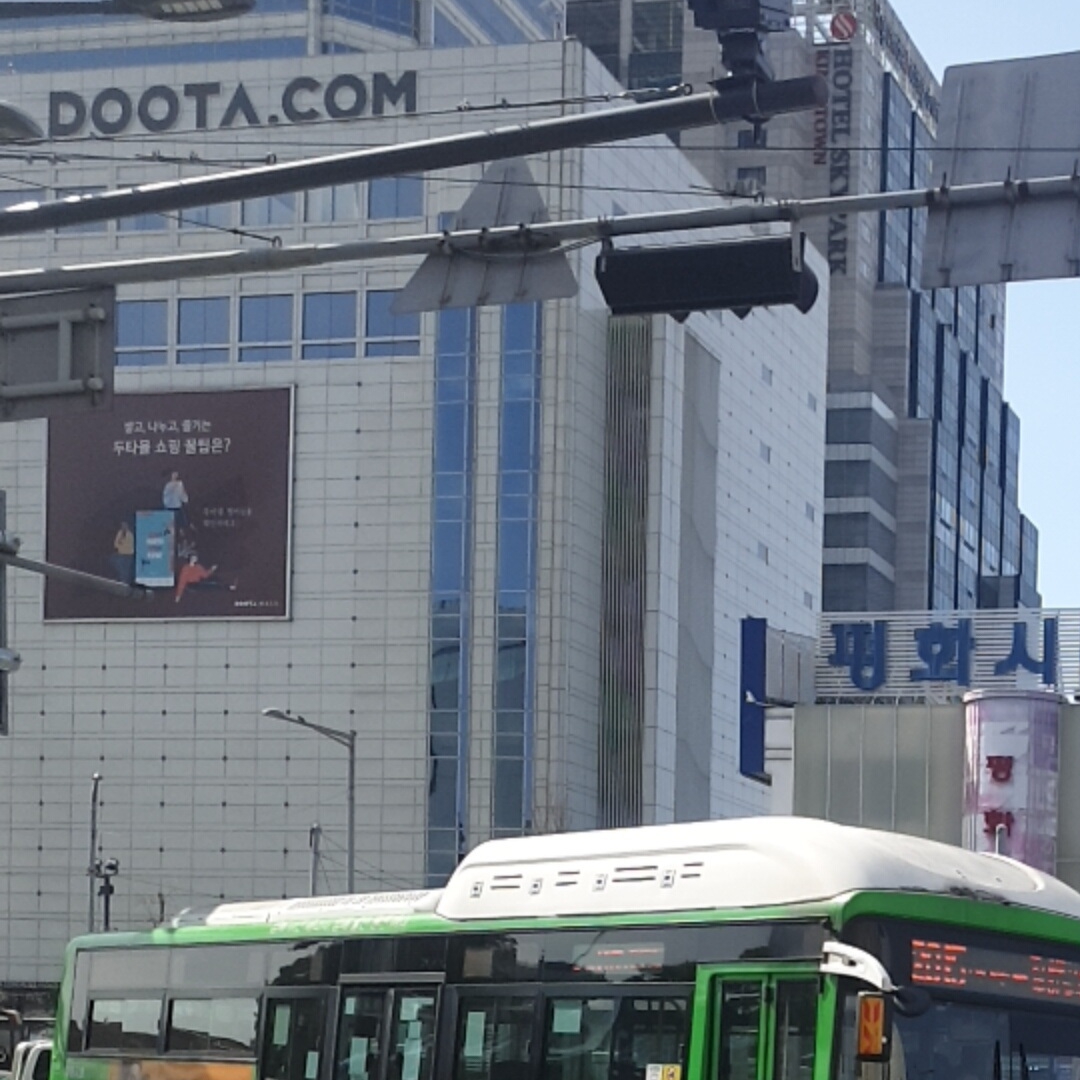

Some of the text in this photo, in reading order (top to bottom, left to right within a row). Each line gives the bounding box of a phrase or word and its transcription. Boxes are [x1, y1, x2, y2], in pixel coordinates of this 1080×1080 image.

[50, 71, 416, 137] DOOTA.COM
[828, 46, 852, 275] HOTEL SKYARK
[113, 437, 231, 456] 두타몰 쇼핑 꿀팁은?
